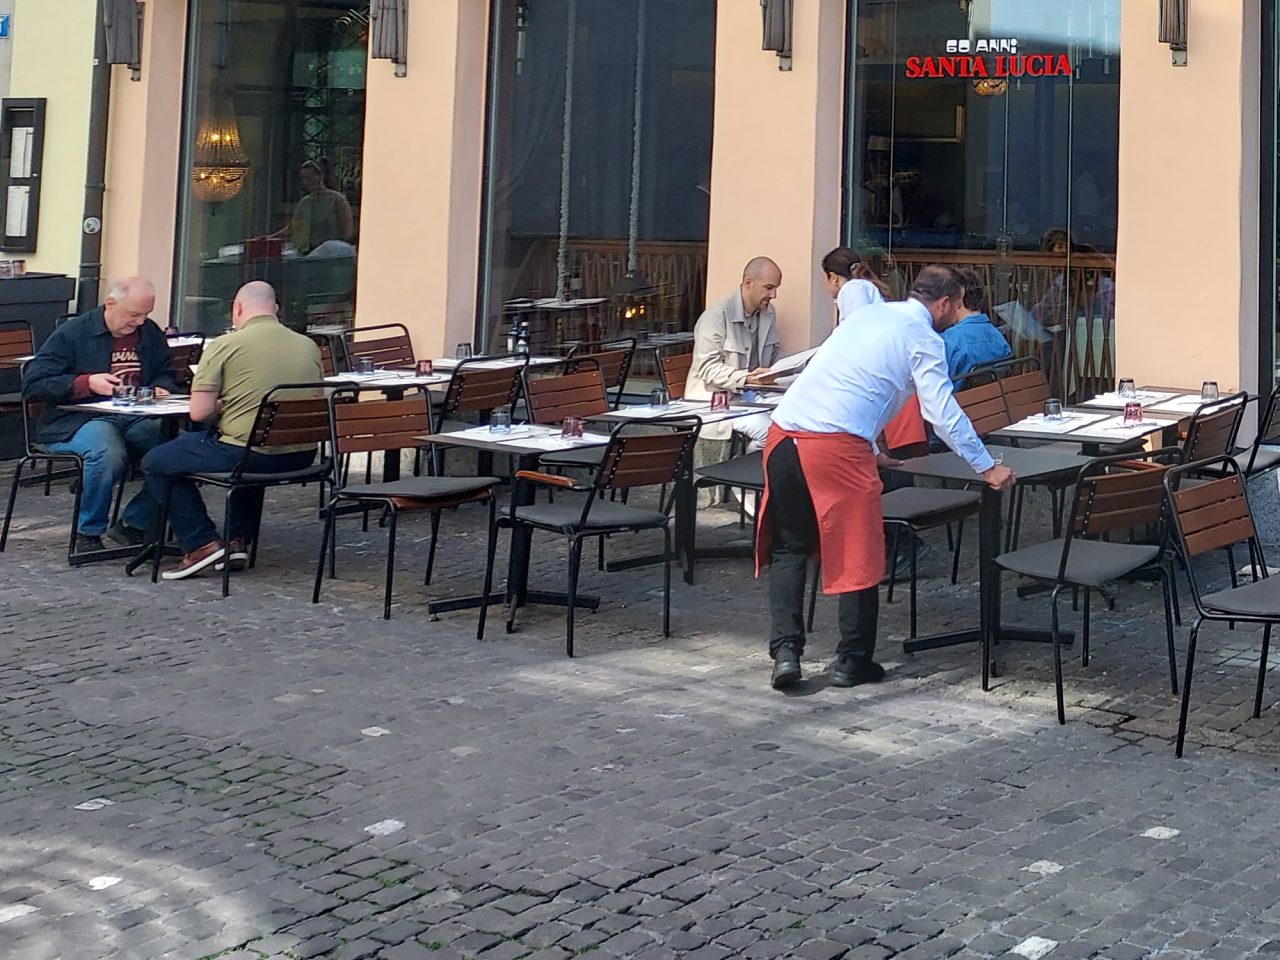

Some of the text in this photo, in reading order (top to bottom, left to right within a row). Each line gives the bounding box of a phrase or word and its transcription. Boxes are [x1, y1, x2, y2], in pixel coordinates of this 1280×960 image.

[946, 38, 970, 53] 60
[905, 53, 1073, 79] SANTA LUCIA
